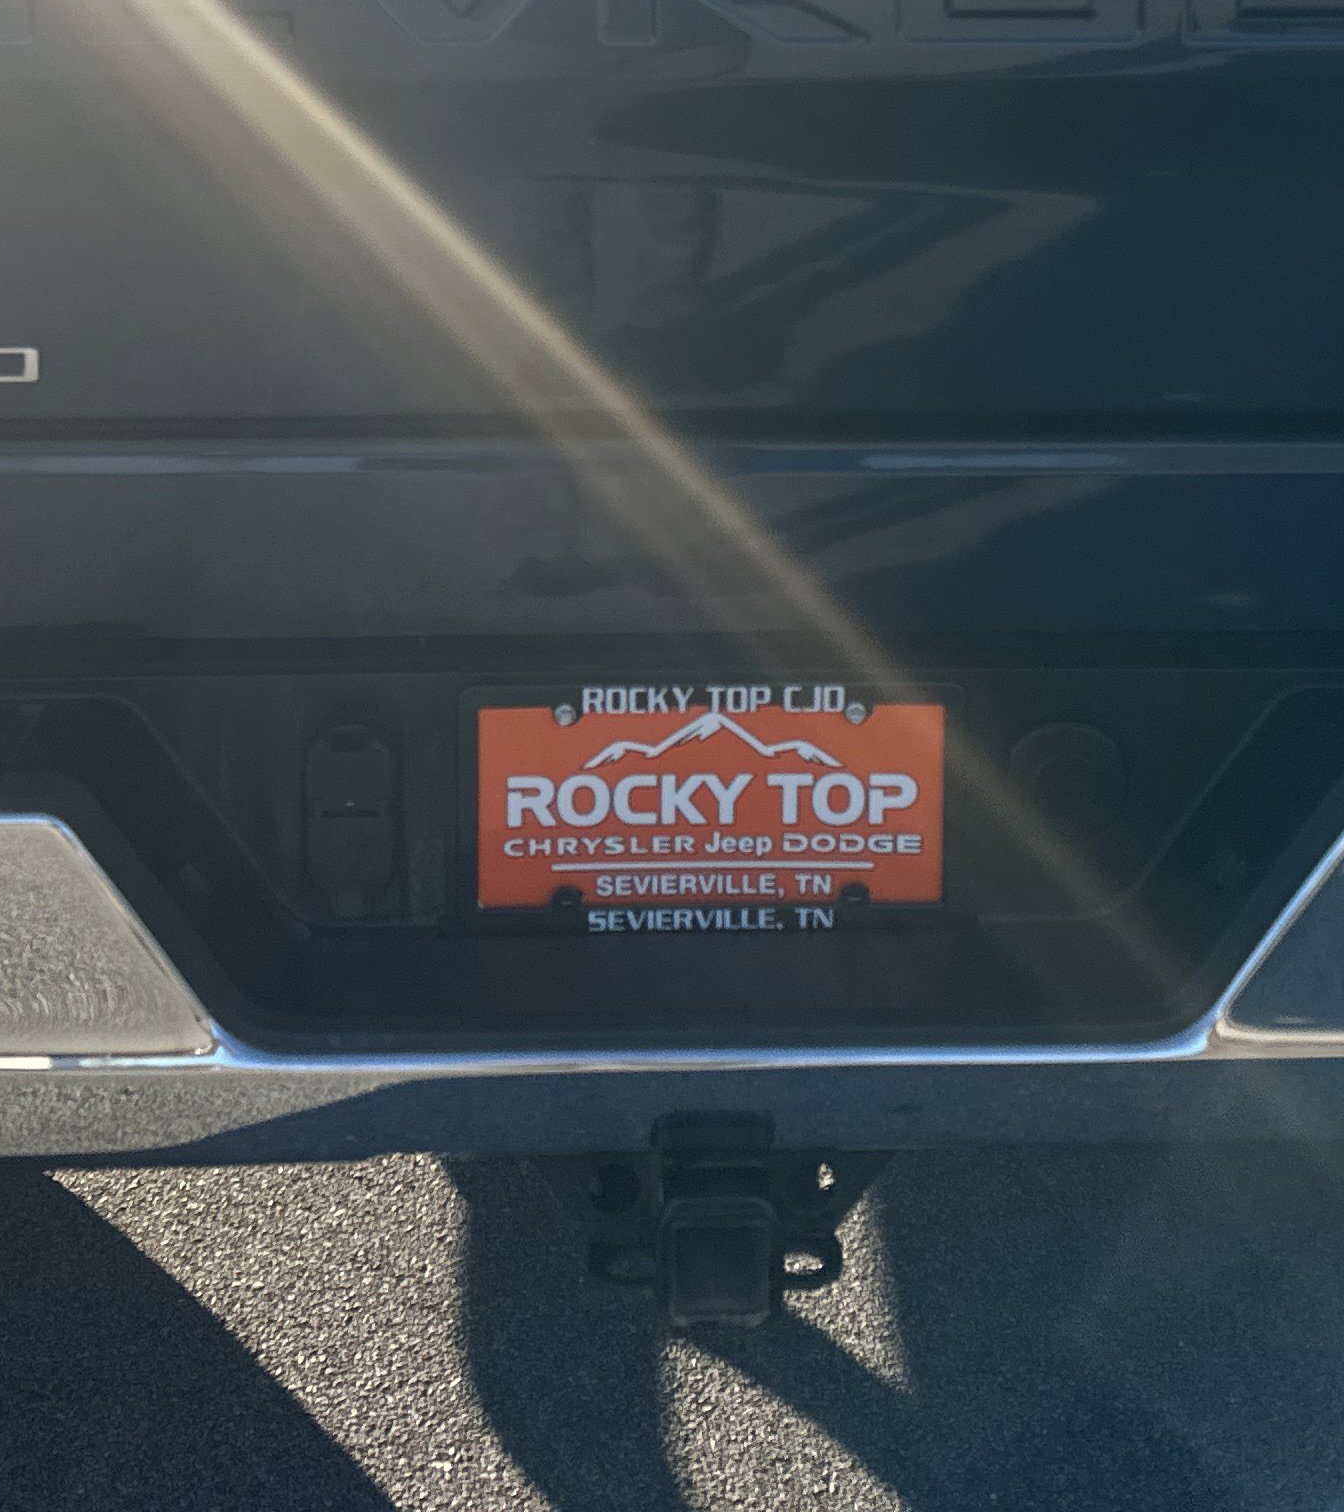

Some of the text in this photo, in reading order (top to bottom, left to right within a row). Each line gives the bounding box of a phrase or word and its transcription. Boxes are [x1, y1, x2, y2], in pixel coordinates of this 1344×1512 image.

[582, 686, 695, 714] ROCKY
[705, 686, 772, 714] TOP
[506, 772, 918, 829] ROCKY TOP
[503, 832, 923, 858] CHRYSLER Jeep DODGE
[596, 874, 832, 899] SEVIERVILLE, TN
[794, 906, 835, 930] TN
